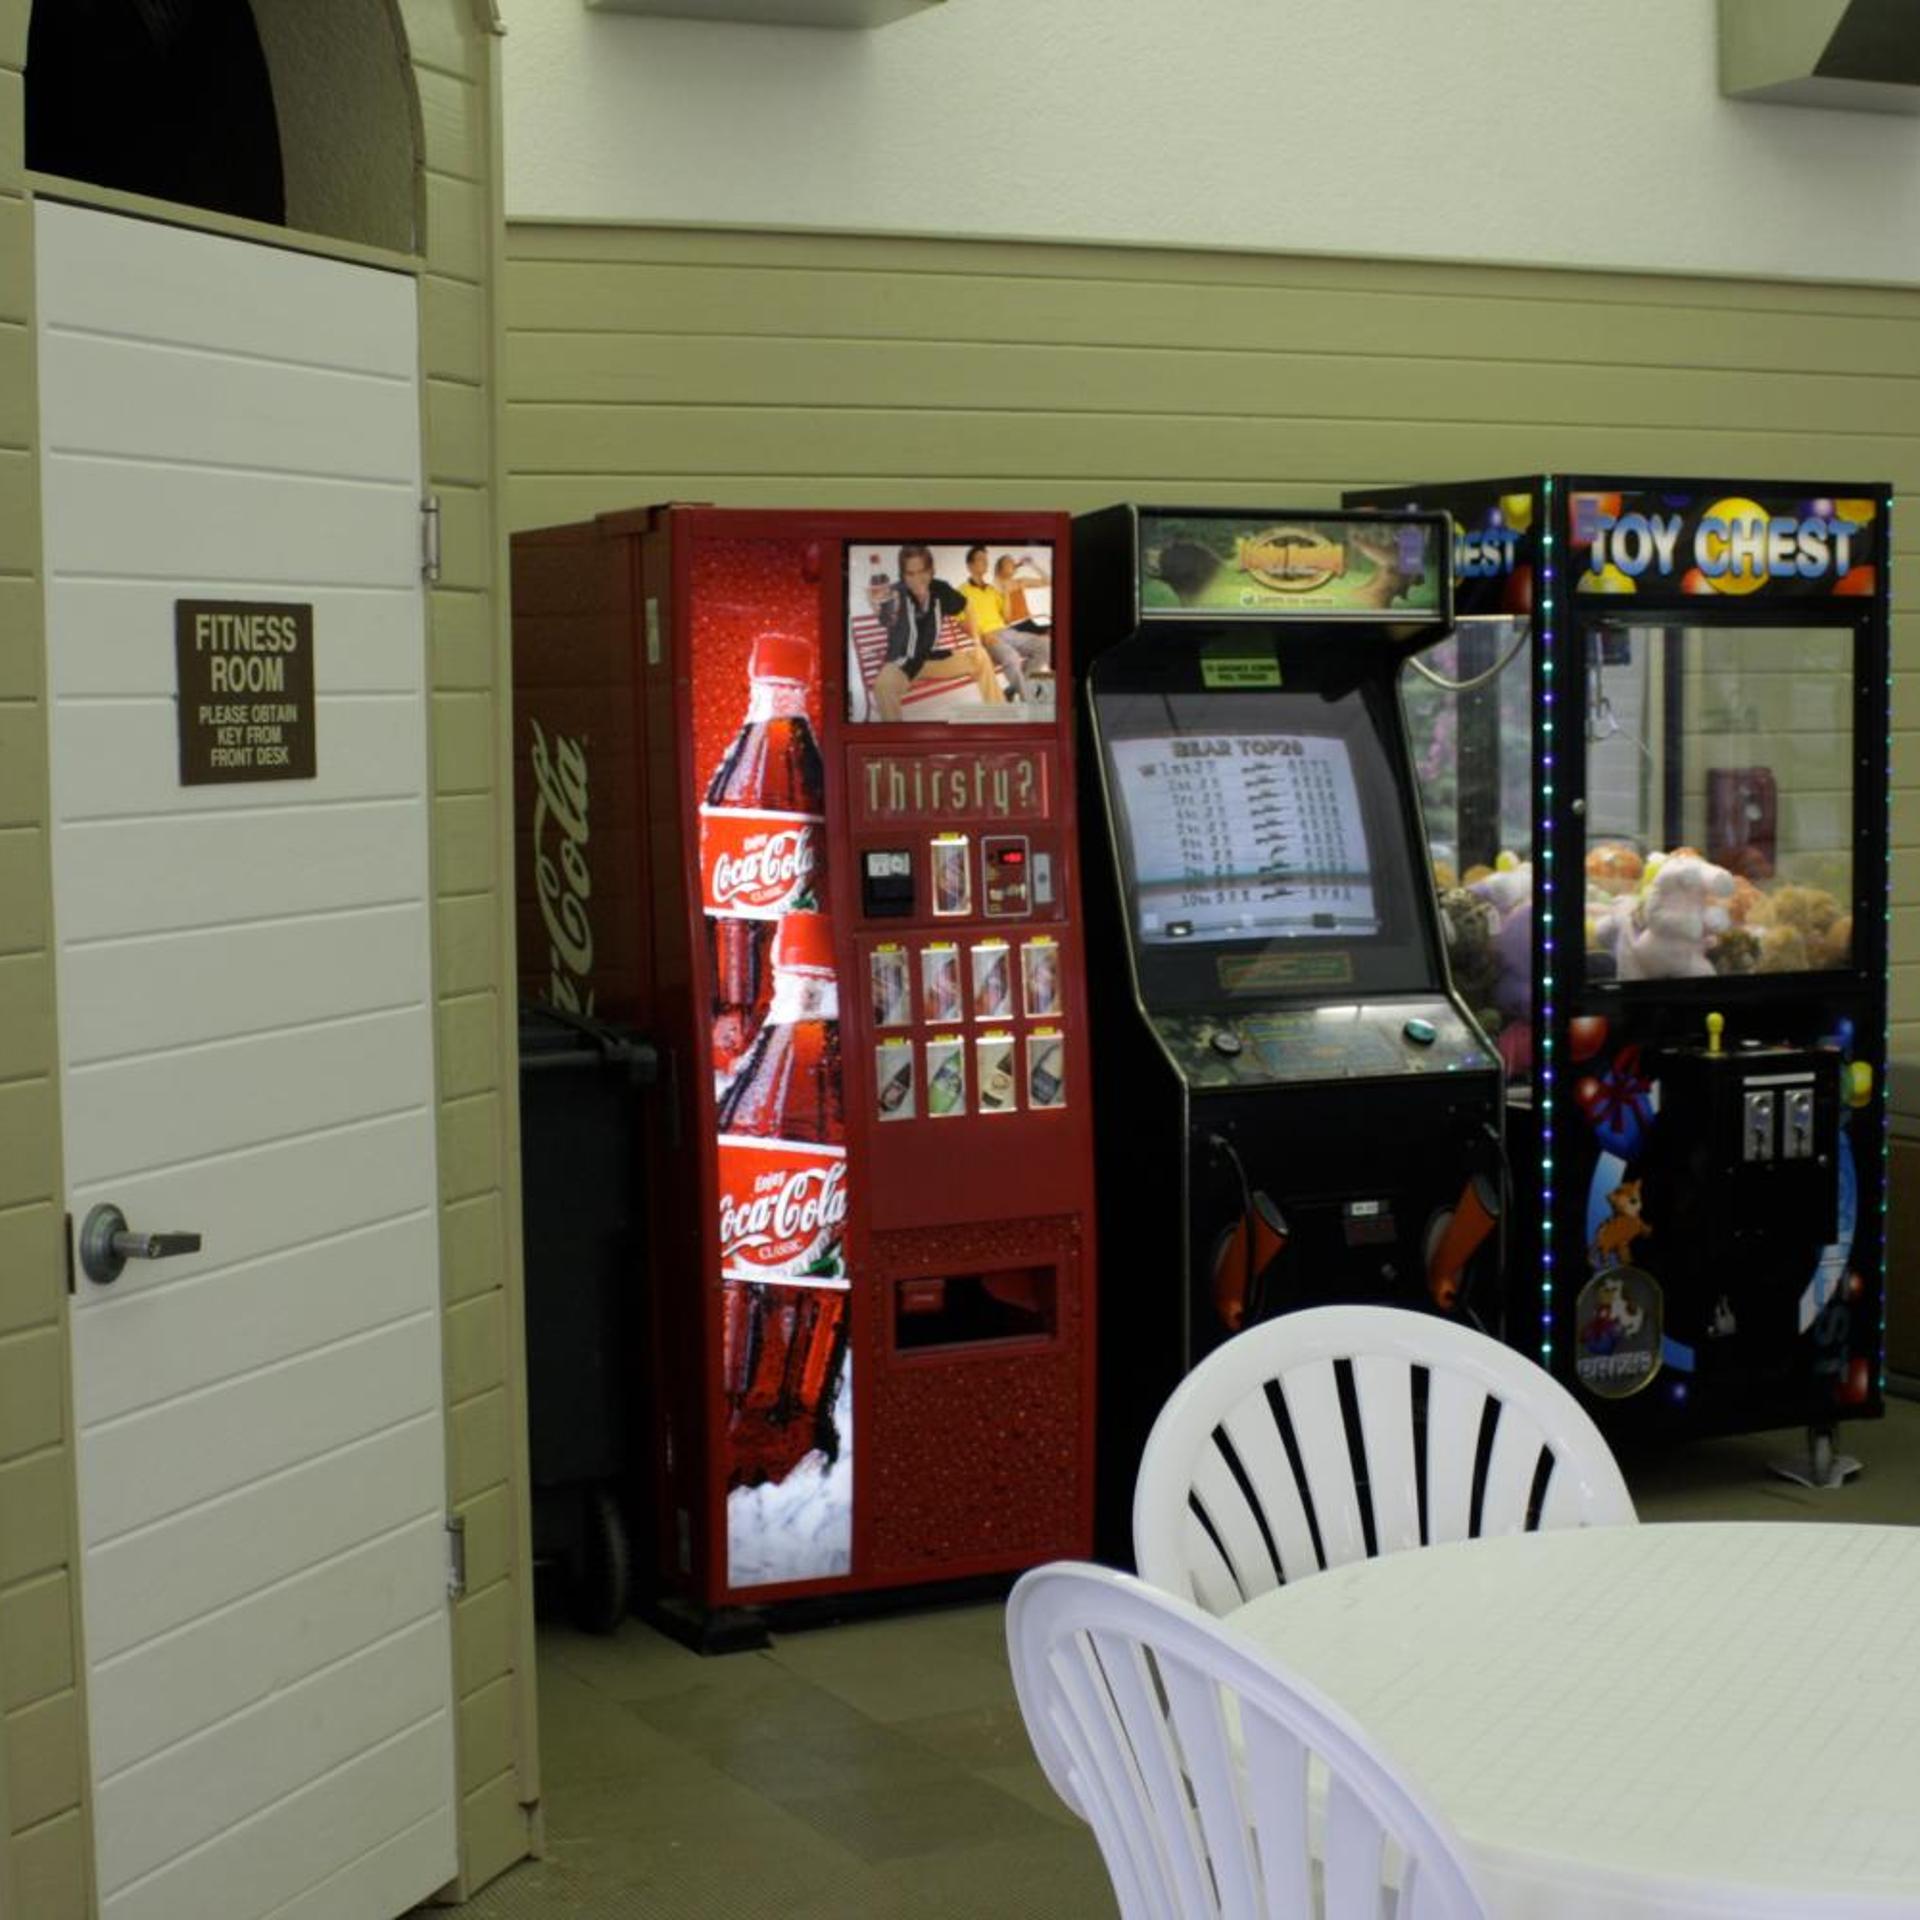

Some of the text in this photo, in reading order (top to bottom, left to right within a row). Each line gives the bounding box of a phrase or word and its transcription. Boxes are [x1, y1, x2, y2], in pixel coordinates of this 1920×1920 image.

[1588, 512, 1860, 579] TOY CHEST
[195, 614, 297, 652] FITNESS
[210, 655, 285, 692] ROOM
[199, 704, 298, 724] PLEASE OBTAIN
[217, 726, 282, 745] KEY FROM
[210, 746, 289, 767] FRONT DESK
[866, 759, 1033, 816] Thirsty?
[712, 825, 814, 903] Coca-Cola
